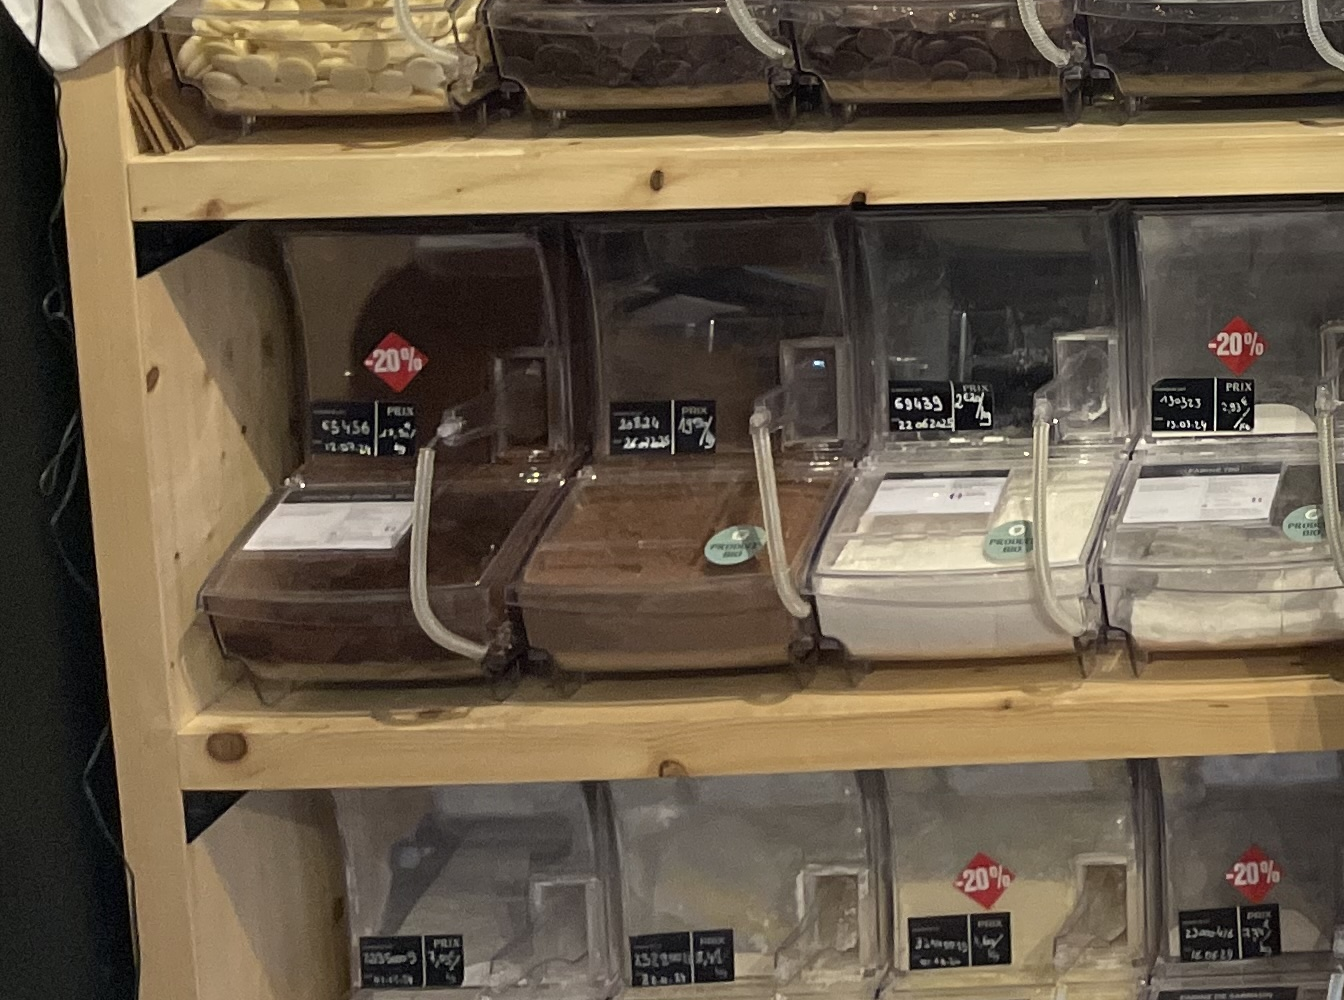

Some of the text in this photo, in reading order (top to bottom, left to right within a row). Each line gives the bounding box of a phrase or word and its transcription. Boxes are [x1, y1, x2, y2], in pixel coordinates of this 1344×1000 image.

[1208, 332, 1264, 356] -20%
[364, 345, 422, 373] -20%
[962, 383, 988, 392] PRIX
[1225, 382, 1252, 392] PRIX
[953, 864, 1012, 893] -20%
[1225, 860, 1280, 887] -20%
